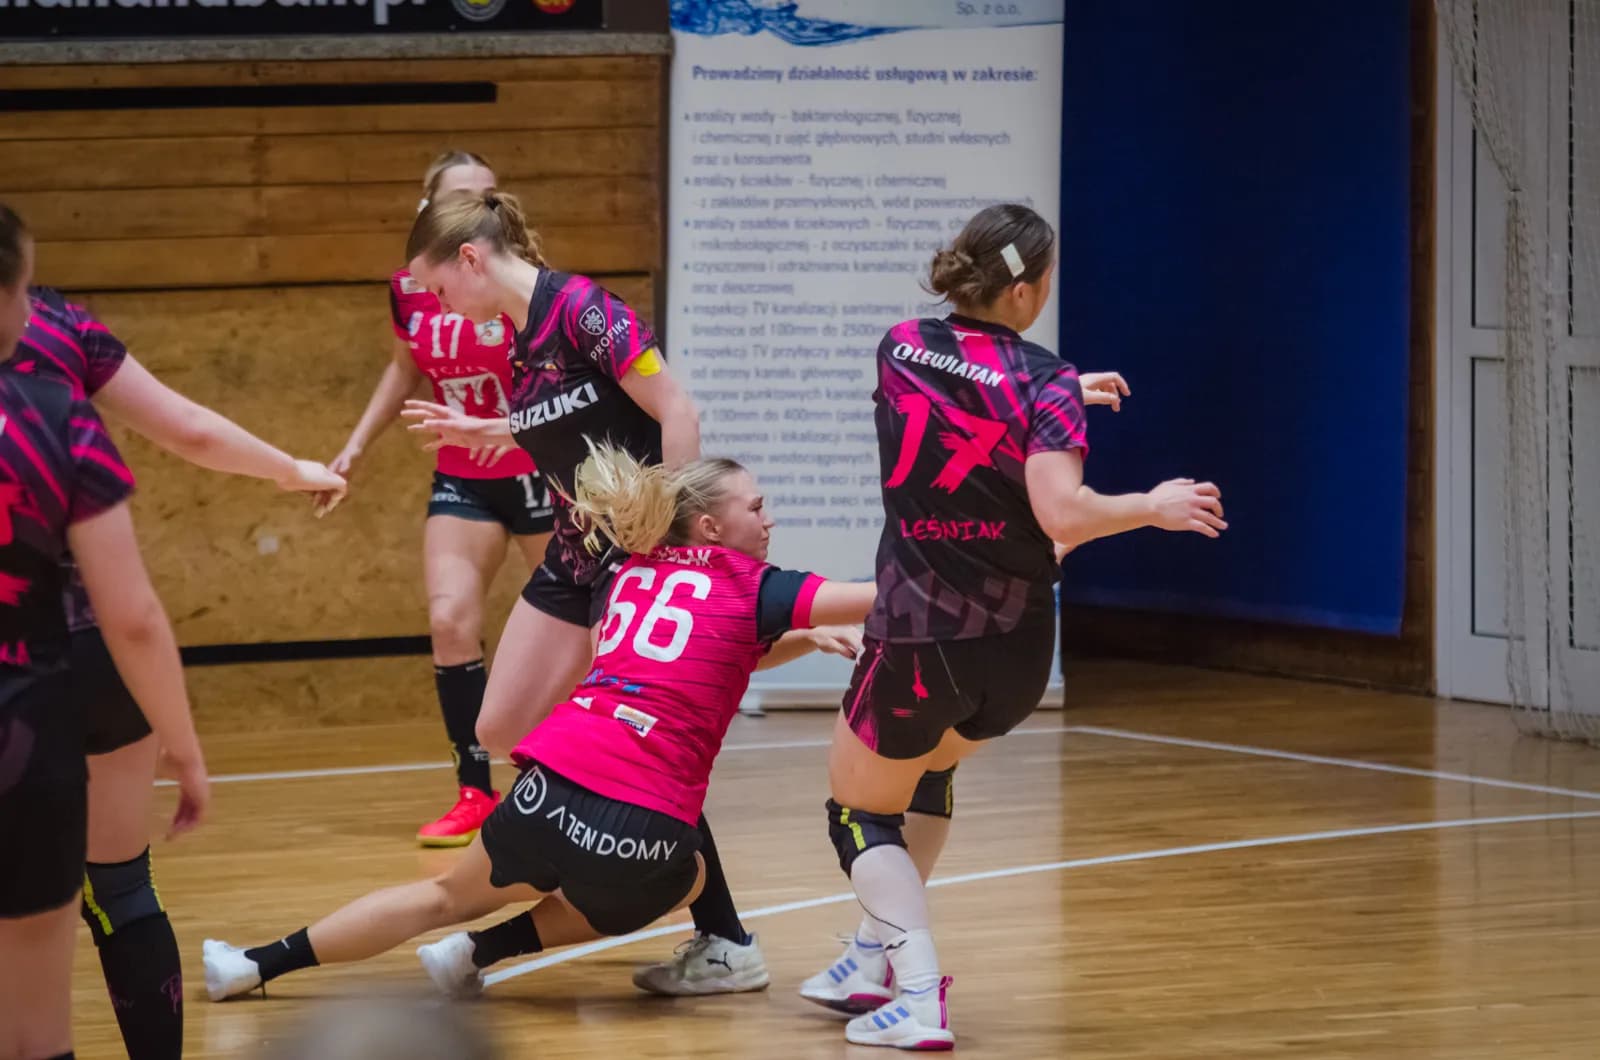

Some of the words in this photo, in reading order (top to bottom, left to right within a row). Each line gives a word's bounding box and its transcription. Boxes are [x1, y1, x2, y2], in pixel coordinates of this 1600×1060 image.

[983, 4, 992, 14] z
[692, 65, 783, 83] Prowadzimy
[788, 65, 870, 80] działalność
[875, 66, 947, 84] usługową
[952, 70, 966, 81] w
[972, 67, 1038, 81] zakresie:
[693, 109, 736, 124] analizy
[740, 109, 775, 125] wody
[906, 109, 962, 125] fizycznej
[699, 131, 771, 149] chemicznej
[693, 173, 735, 188] analizy
[809, 173, 863, 189] fizycznej
[874, 174, 946, 189] chemicznej
[693, 216, 735, 231] analizy
[753, 302, 769, 314] TV
[429, 312, 464, 359] 17
[590, 317, 632, 361] PROFIKA
[753, 345, 769, 357] TV
[509, 382, 599, 434] SUZUKI
[884, 392, 1009, 494] 17
[900, 514, 1006, 541] LEŚNIAK
[598, 566, 712, 663] 66
